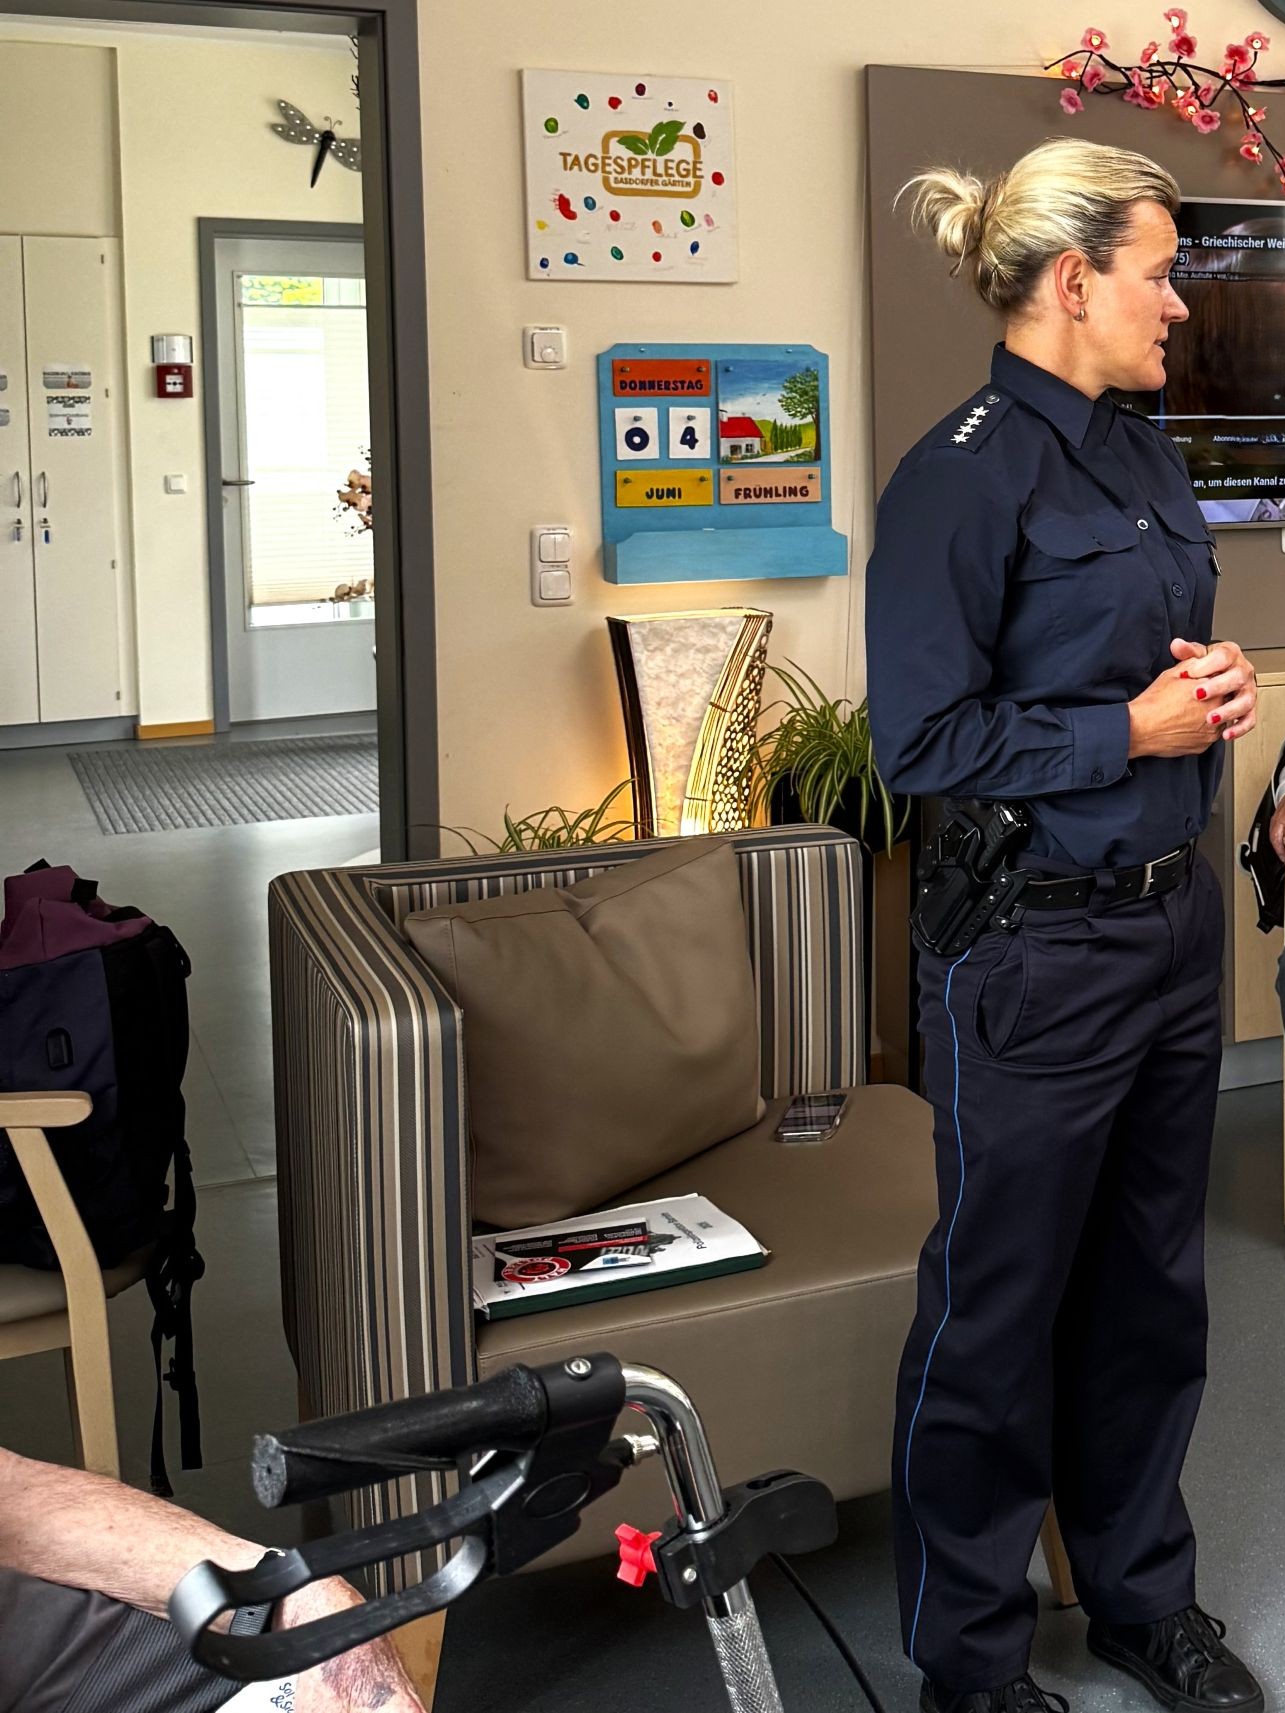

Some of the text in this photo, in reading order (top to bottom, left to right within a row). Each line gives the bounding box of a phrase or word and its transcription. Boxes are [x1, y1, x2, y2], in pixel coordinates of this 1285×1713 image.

[559, 152, 705, 179] TAGESPFLEGE
[613, 176, 692, 188] BASDORFER GÄRTEN
[1201, 235, 1266, 249] Griechischer
[619, 380, 704, 392] DONNERSTAG
[624, 426, 699, 452] 0 4
[1193, 479, 1207, 488] an,
[1208, 479, 1222, 487] um
[1223, 476, 1252, 487] diesen
[1253, 476, 1277, 486] Kanal
[645, 487, 682, 500] JUNI
[734, 484, 809, 499] FRÜHLING
